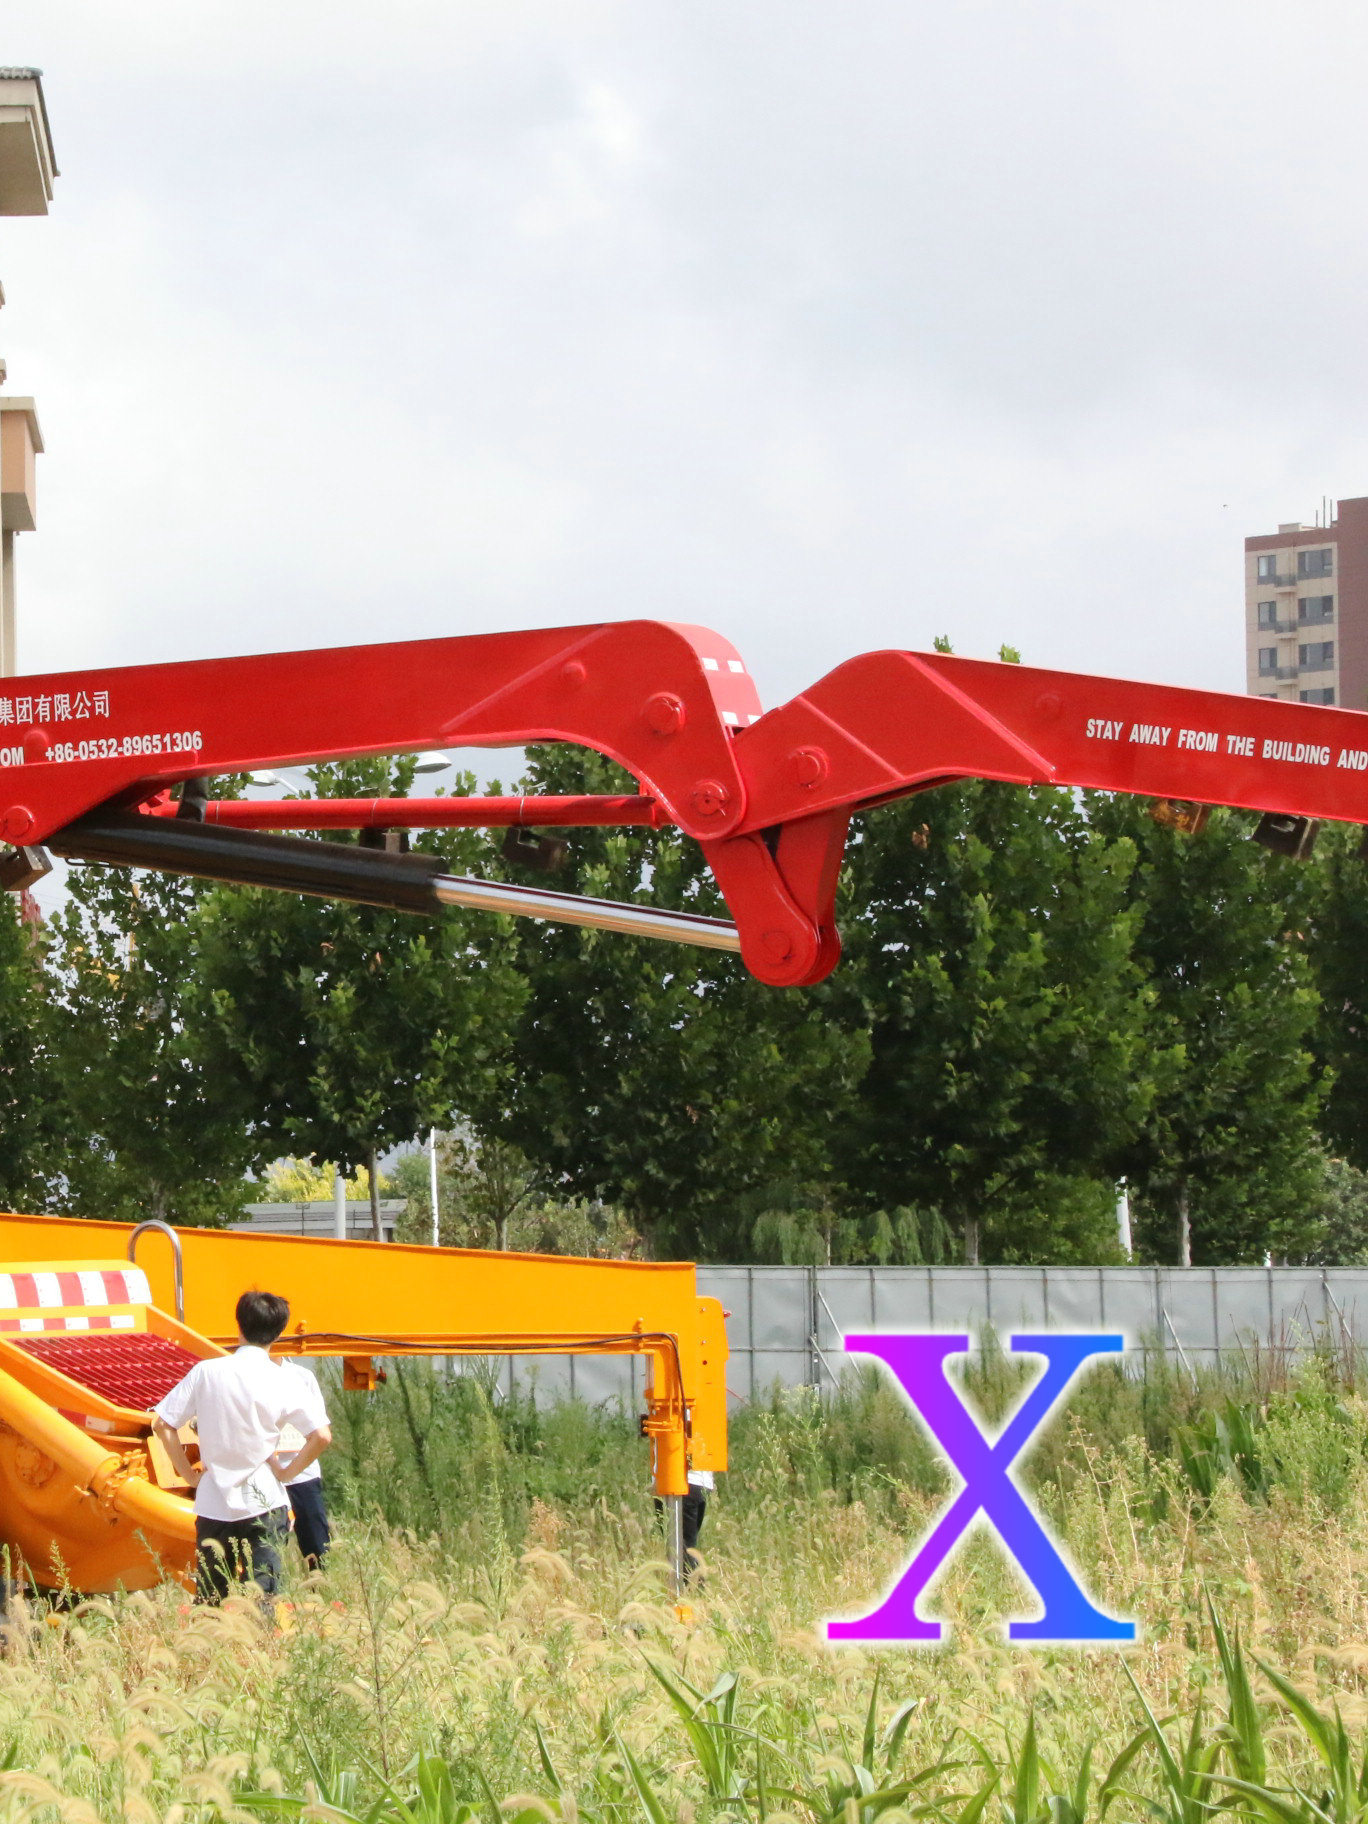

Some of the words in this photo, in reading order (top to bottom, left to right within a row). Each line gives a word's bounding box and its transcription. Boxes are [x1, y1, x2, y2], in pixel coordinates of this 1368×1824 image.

[45, 731, 203, 763] +86-0532-89651306
[1086, 718, 1123, 741] STAY
[1129, 724, 1171, 746] AWAY
[1177, 729, 1219, 752] FROM
[1226, 735, 1255, 757] THE
[1262, 739, 1330, 766] BUILDING
[1337, 748, 1368, 771] AND
